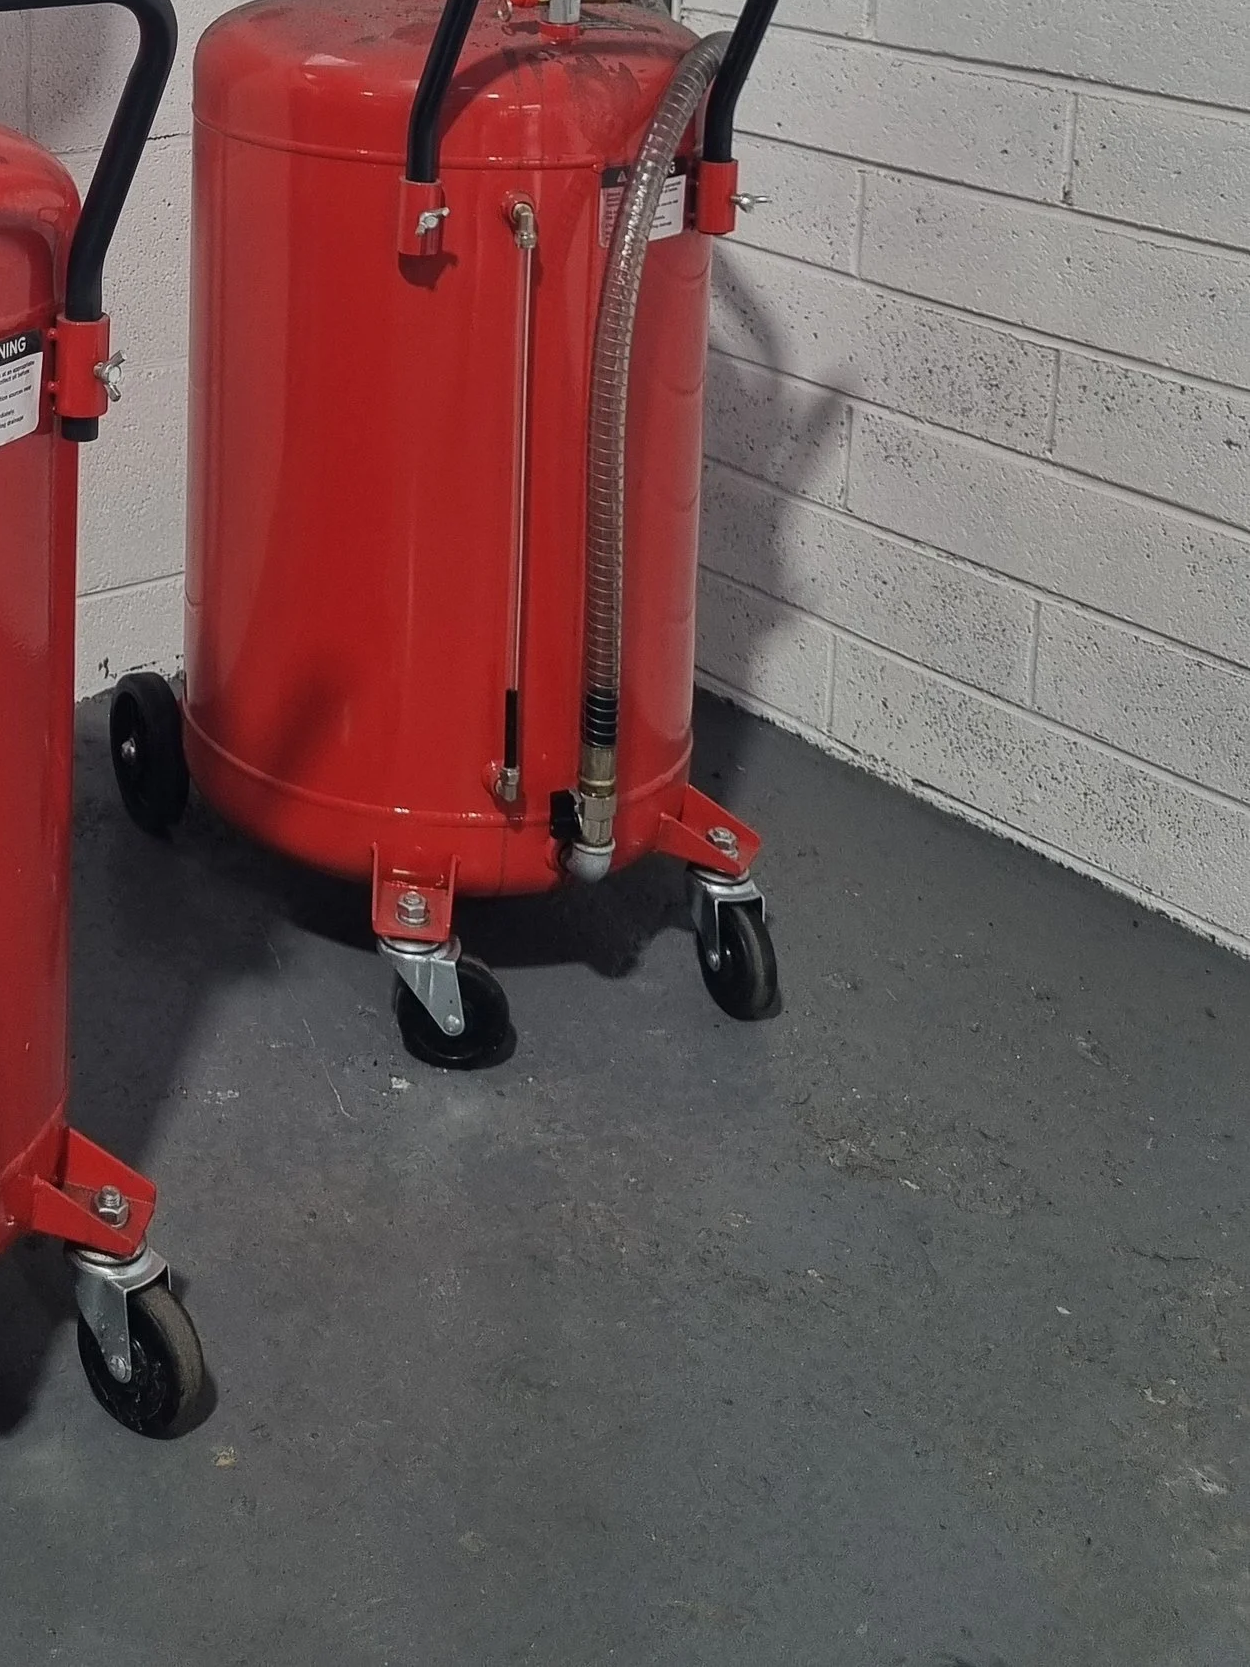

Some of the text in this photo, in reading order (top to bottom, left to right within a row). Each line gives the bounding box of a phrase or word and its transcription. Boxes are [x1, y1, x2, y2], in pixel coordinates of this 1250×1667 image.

[12, 360, 34, 374] appropriate
[18, 370, 30, 378] before
[8, 389, 23, 398] sources
